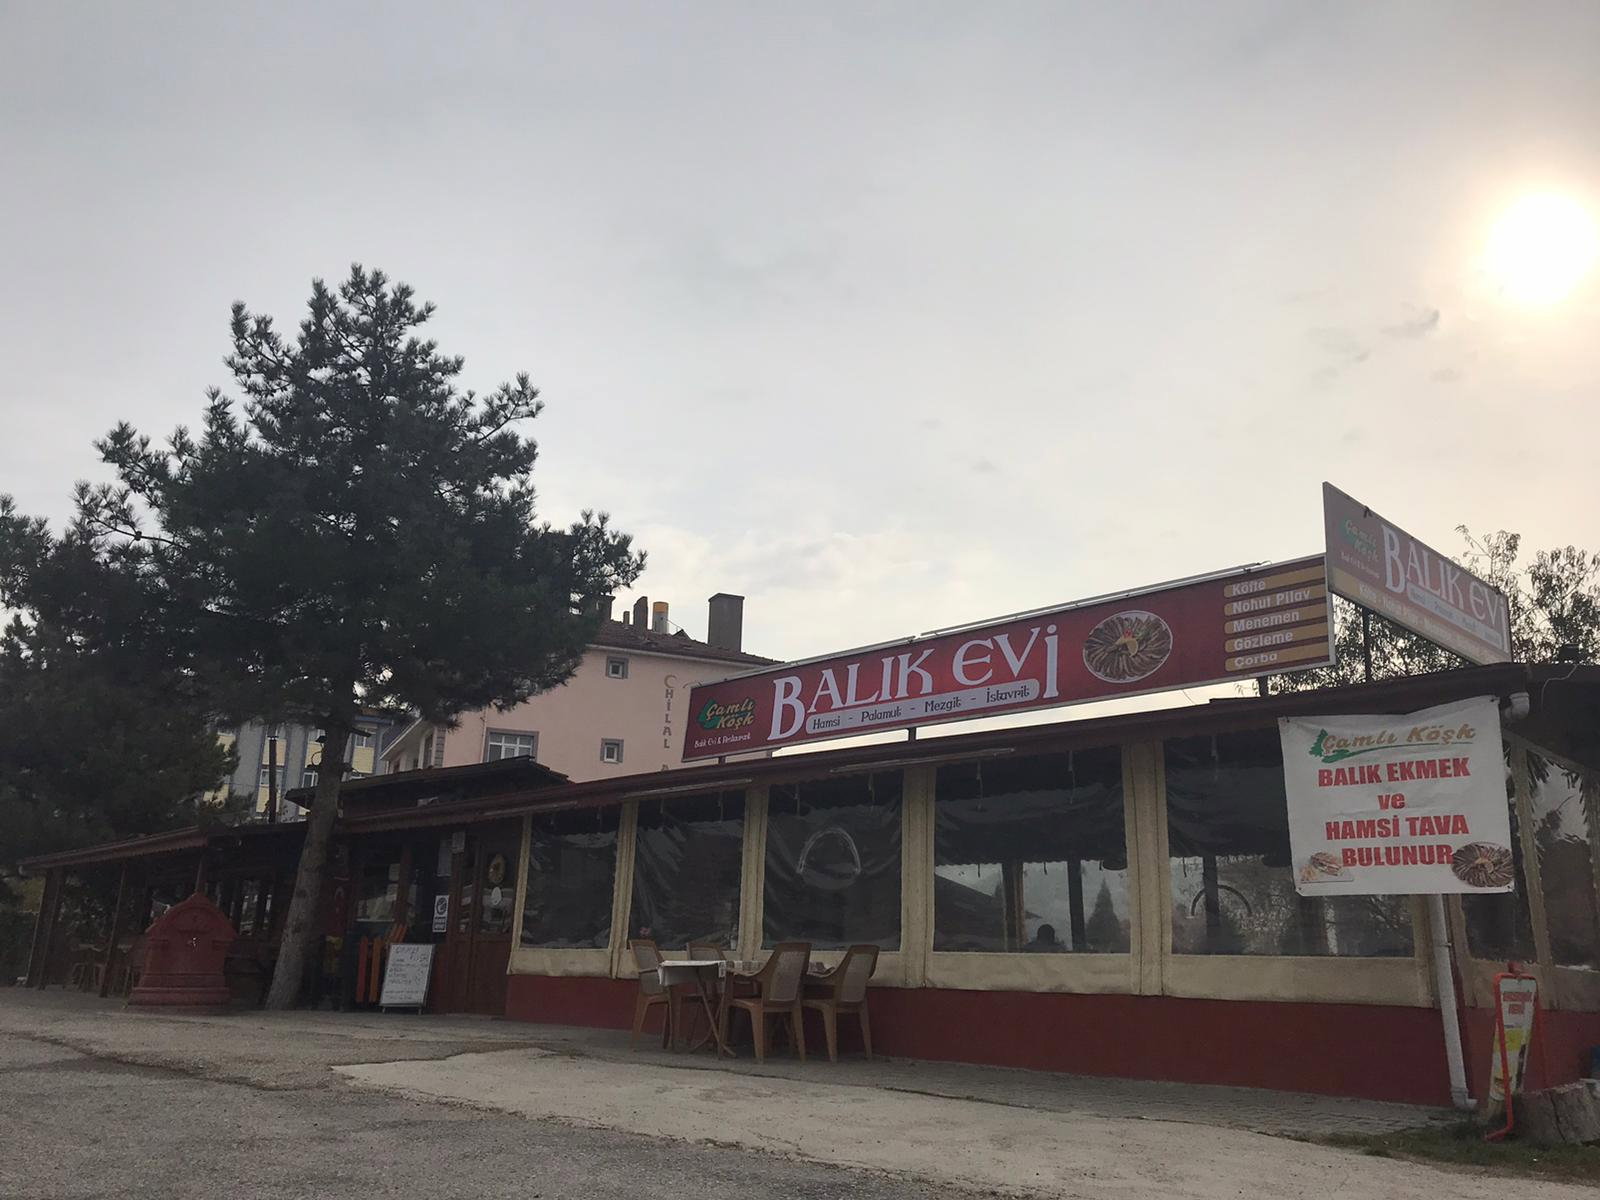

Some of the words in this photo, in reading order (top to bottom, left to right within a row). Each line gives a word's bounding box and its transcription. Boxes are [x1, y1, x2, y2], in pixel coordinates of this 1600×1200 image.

[1381, 524, 1464, 611] BALIK
[1233, 611, 1300, 632] Menemen
[1234, 631, 1294, 650] Gözleme
[767, 648, 935, 741] BALIK
[706, 697, 755, 720] Çamlı
[716, 711, 755, 730] Köşk
[813, 715, 841, 730] Hamsi
[861, 706, 902, 723] Palamut
[925, 696, 961, 714] Mezgit
[1322, 730, 1397, 756] Çamlı
[1406, 723, 1477, 746] Köşk
[1318, 764, 1383, 787] BALIK
[1387, 757, 1471, 783] EKMEK
[1377, 793, 1405, 810] ve
[1325, 815, 1400, 840] HAMSİ
[1405, 814, 1469, 836] TAVA
[1342, 844, 1455, 867] BULUNUR
